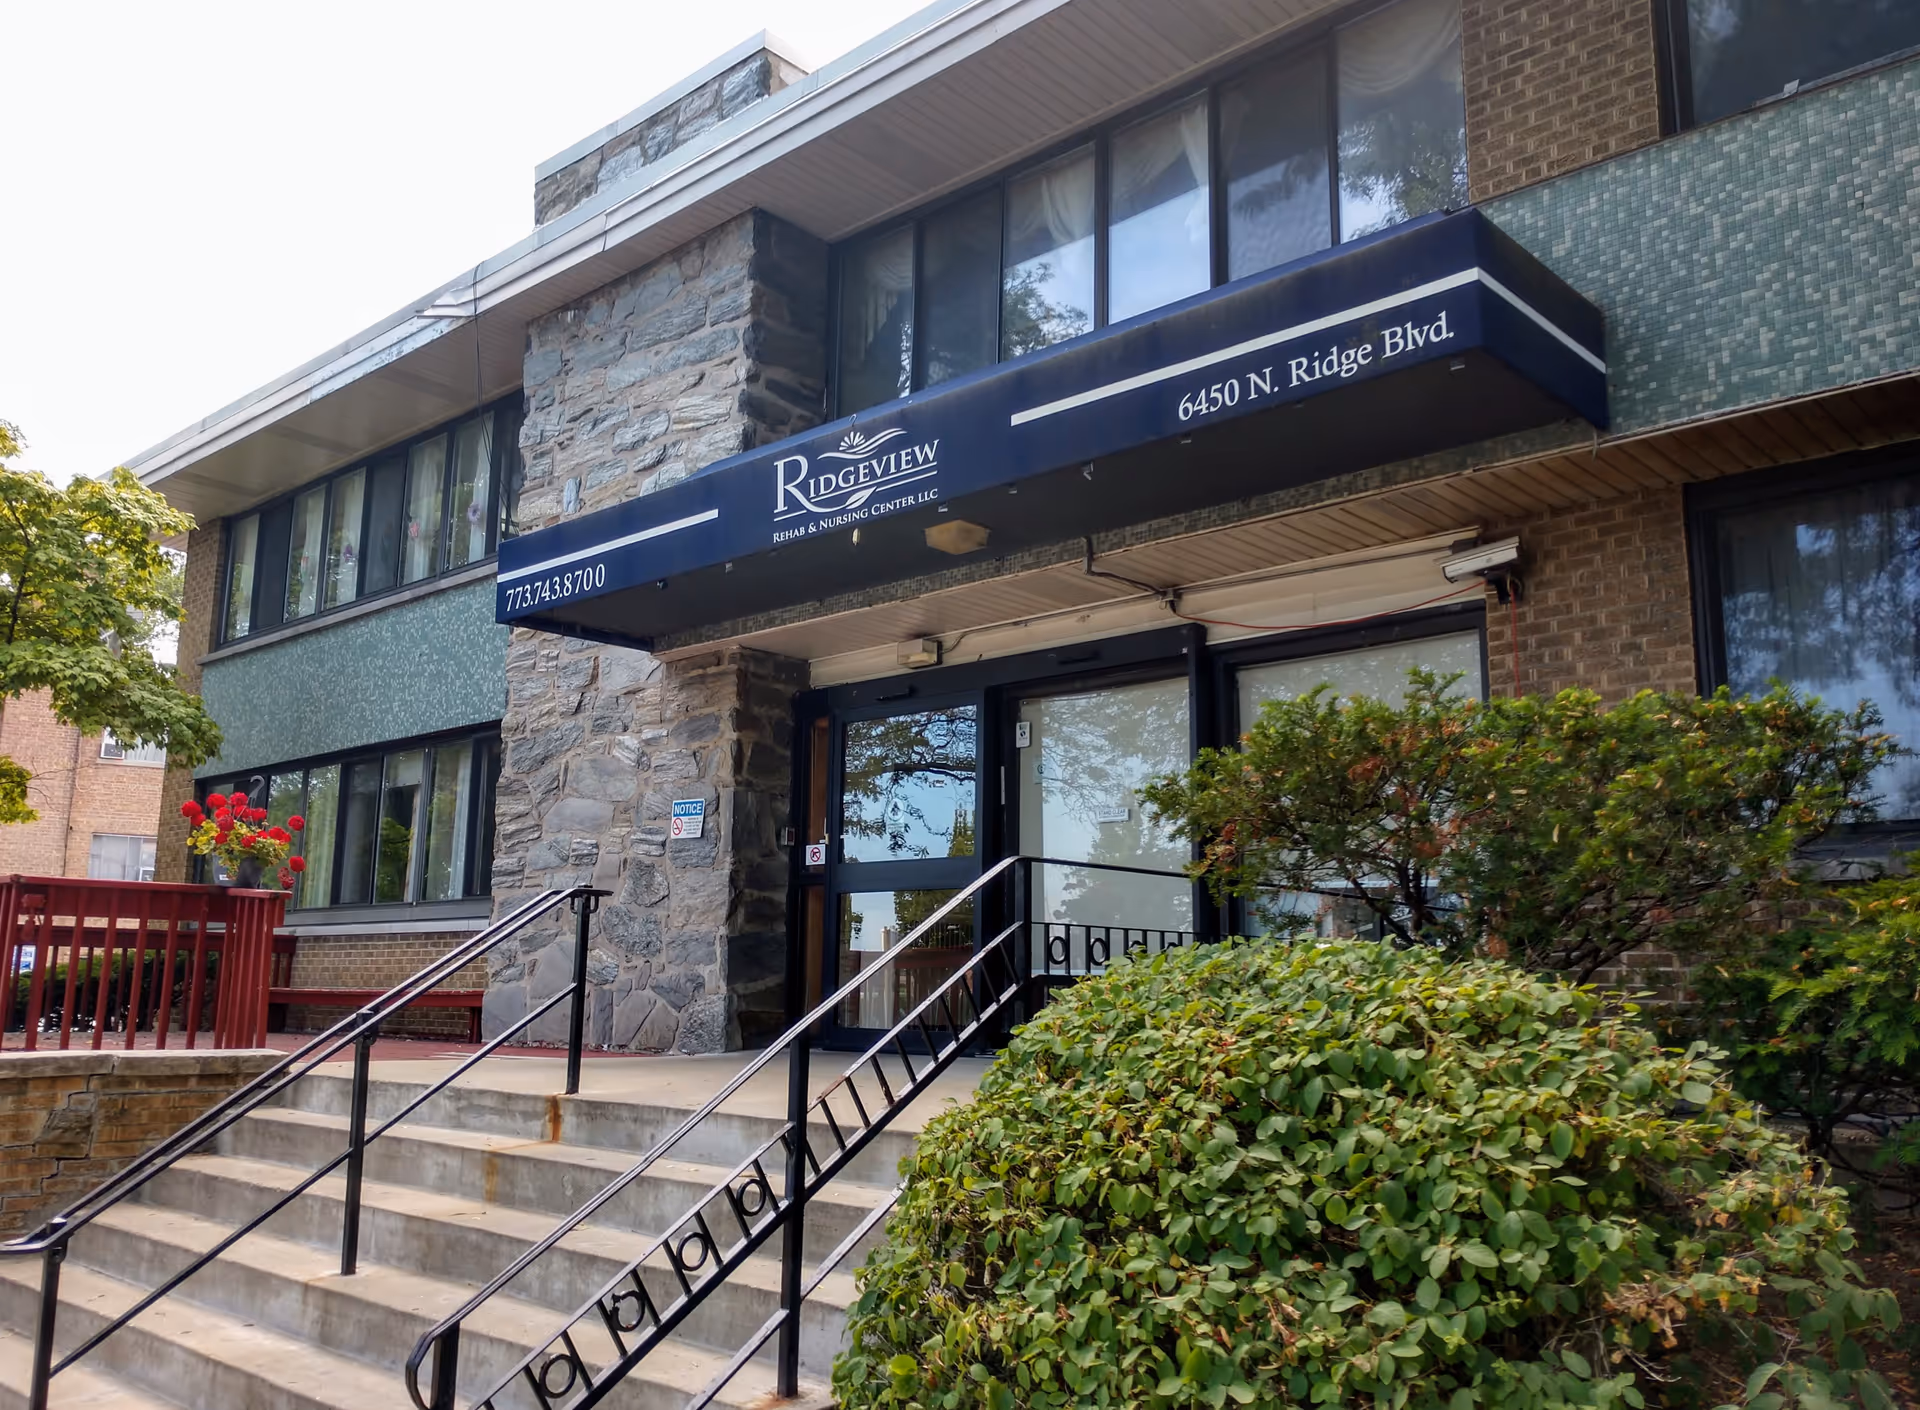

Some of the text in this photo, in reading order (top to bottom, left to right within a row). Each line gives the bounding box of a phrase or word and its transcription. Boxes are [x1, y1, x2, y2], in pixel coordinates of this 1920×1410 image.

[1178, 311, 1454, 421] 6450 N. Ridge Blvd.
[774, 439, 940, 513] RIDGEVIEW
[773, 488, 938, 543] REHAB & NURSING CENTER LLC
[505, 564, 605, 612] 773.743.8700
[674, 803, 702, 815] NOTICE
